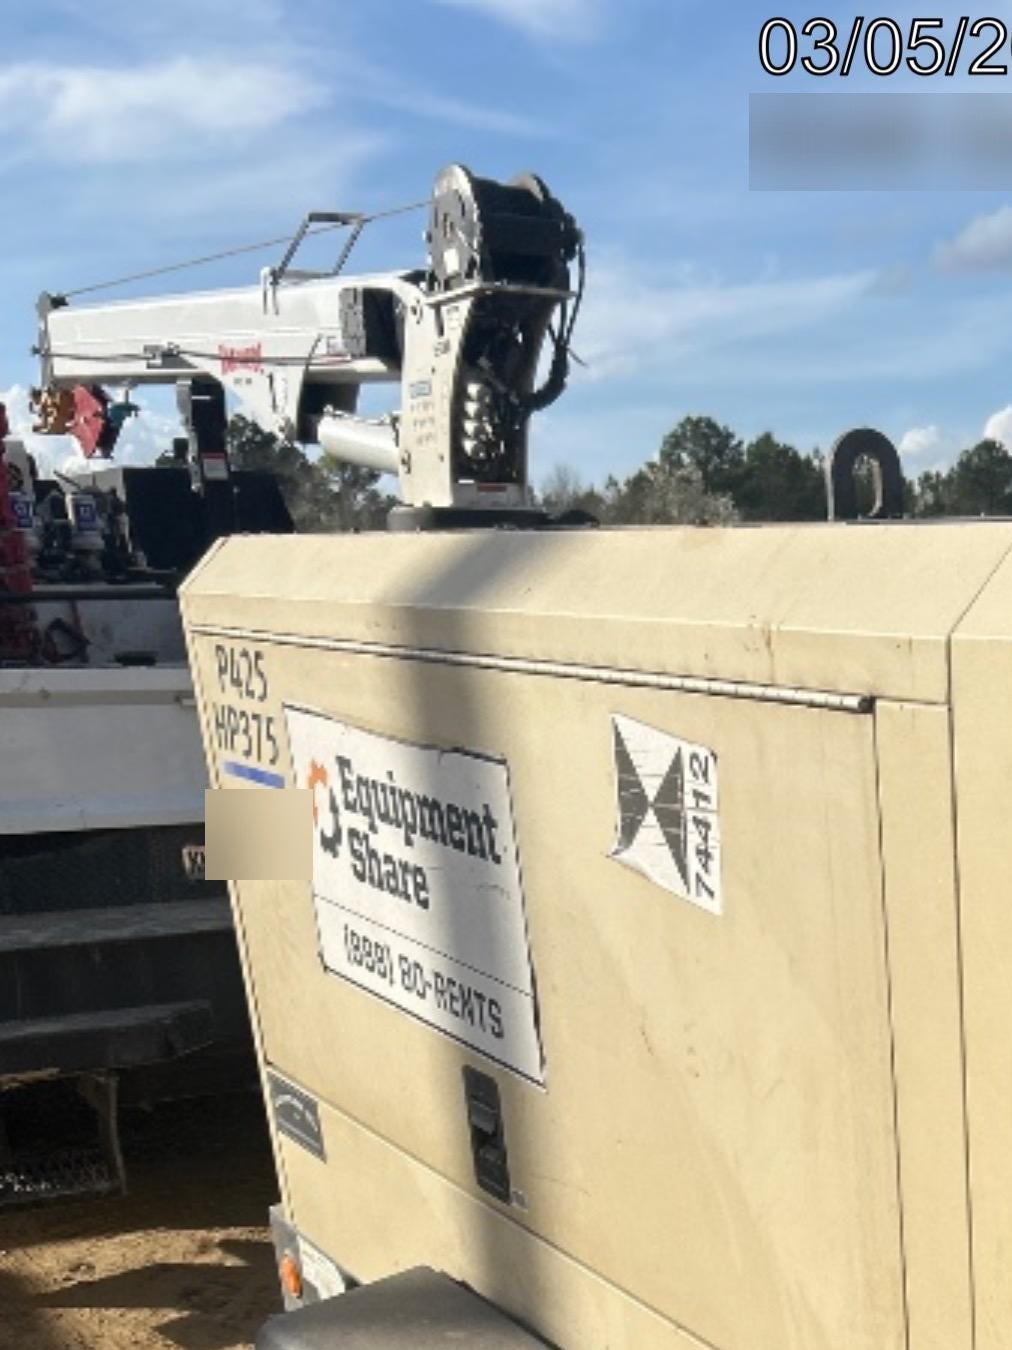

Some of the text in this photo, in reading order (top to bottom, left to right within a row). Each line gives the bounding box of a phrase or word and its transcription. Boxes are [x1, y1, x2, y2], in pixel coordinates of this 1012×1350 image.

[215, 644, 268, 702] P425
[213, 701, 280, 766] HP375
[335, 755, 502, 865] Equipment
[347, 826, 430, 911] Share
[343, 922, 506, 1040] (888) 80-RENTS
